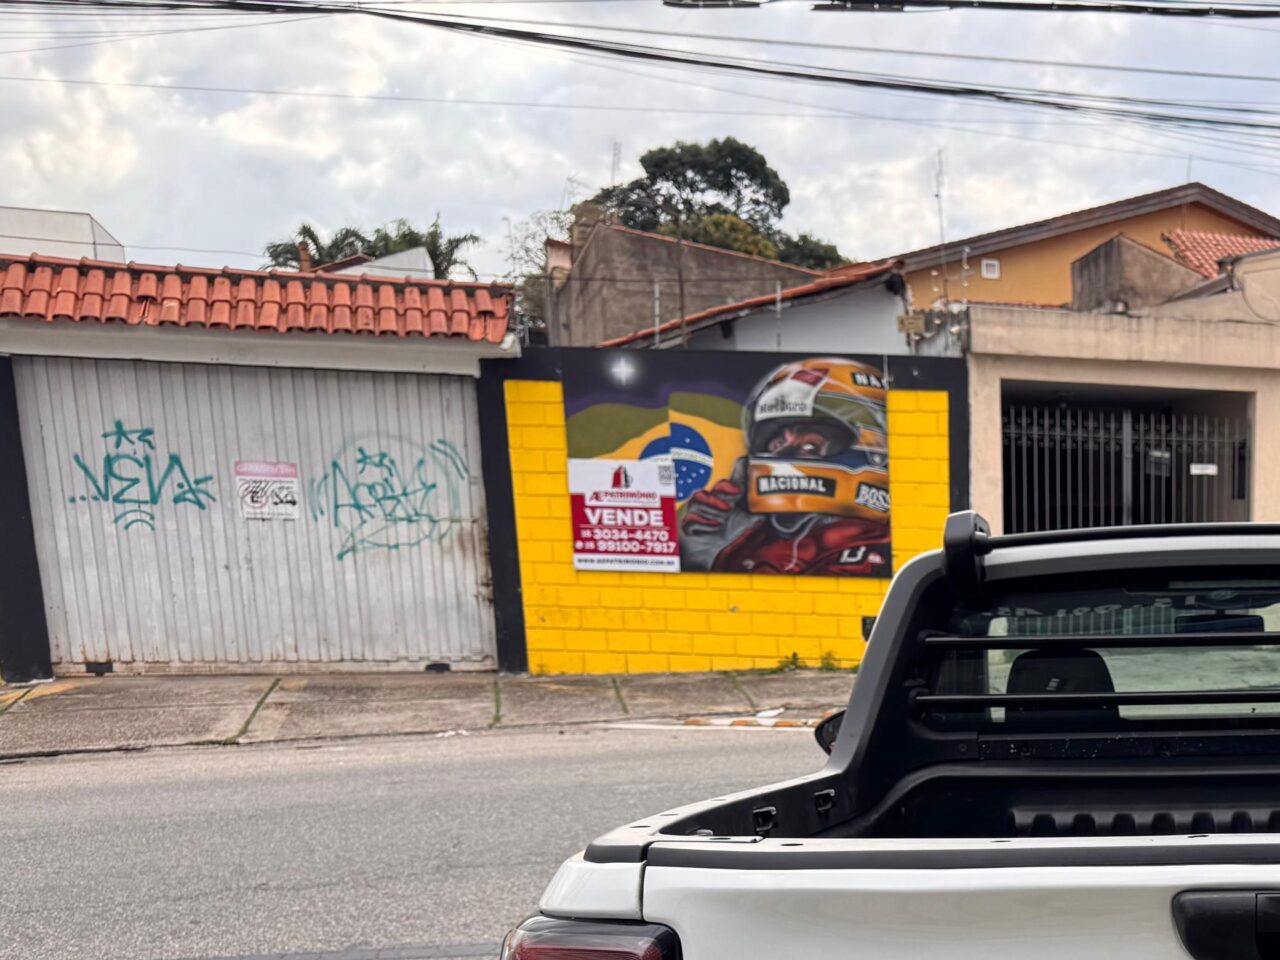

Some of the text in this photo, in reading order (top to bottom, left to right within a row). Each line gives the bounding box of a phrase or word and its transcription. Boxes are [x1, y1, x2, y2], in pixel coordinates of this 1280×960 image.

[758, 477, 827, 493] NACIONAL
[583, 508, 664, 527] VENDE
[597, 540, 676, 553] 99100-7917
